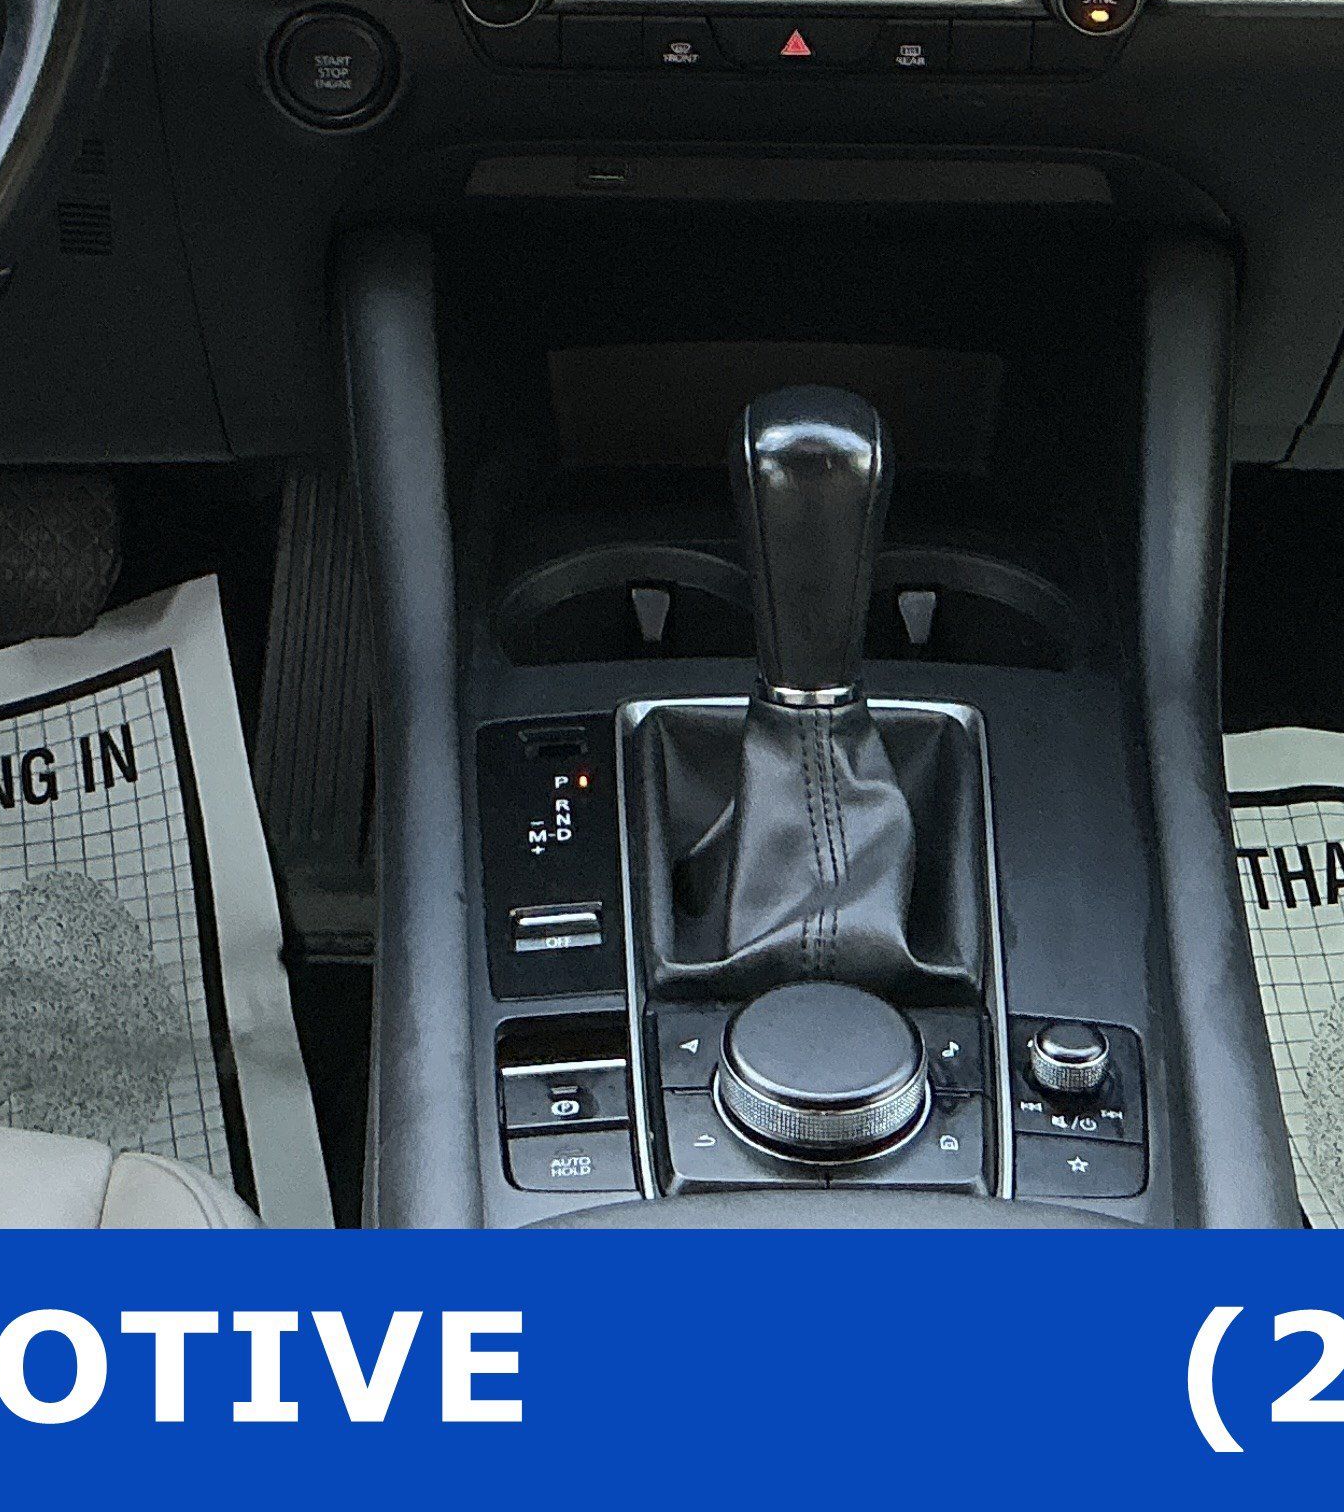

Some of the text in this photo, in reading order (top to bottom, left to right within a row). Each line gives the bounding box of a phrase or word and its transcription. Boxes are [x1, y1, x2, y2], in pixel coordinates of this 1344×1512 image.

[315, 55, 353, 67] START
[663, 53, 699, 64] FRONT
[317, 67, 351, 79] STOP
[78, 724, 139, 794] IN
[554, 776, 570, 788] P
[555, 800, 571, 811] R
[556, 813, 572, 826] N
[550, 1156, 591, 1167] AUTO
[550, 1166, 591, 1178] HOLD
